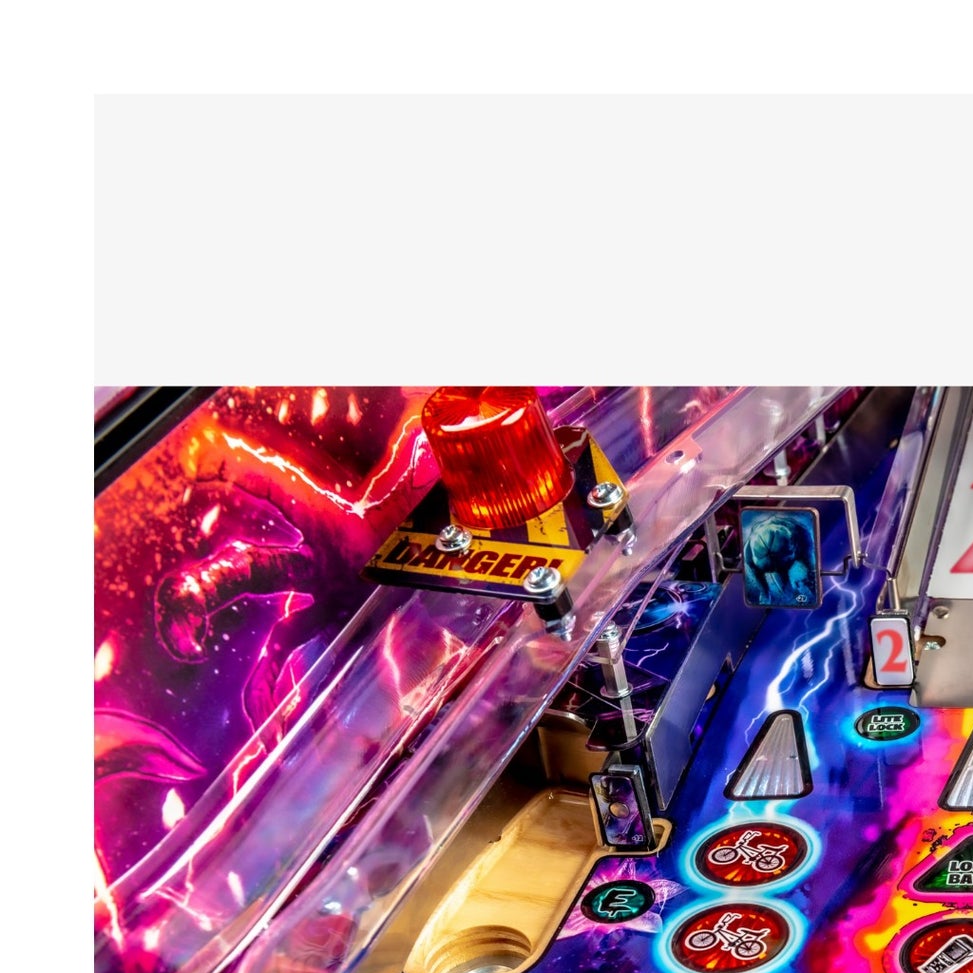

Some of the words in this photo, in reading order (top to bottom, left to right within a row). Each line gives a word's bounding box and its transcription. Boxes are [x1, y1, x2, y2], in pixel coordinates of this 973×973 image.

[876, 629, 908, 673] 2
[868, 722, 905, 732] LOCK
[872, 714, 904, 723] LITE
[598, 888, 637, 918] E
